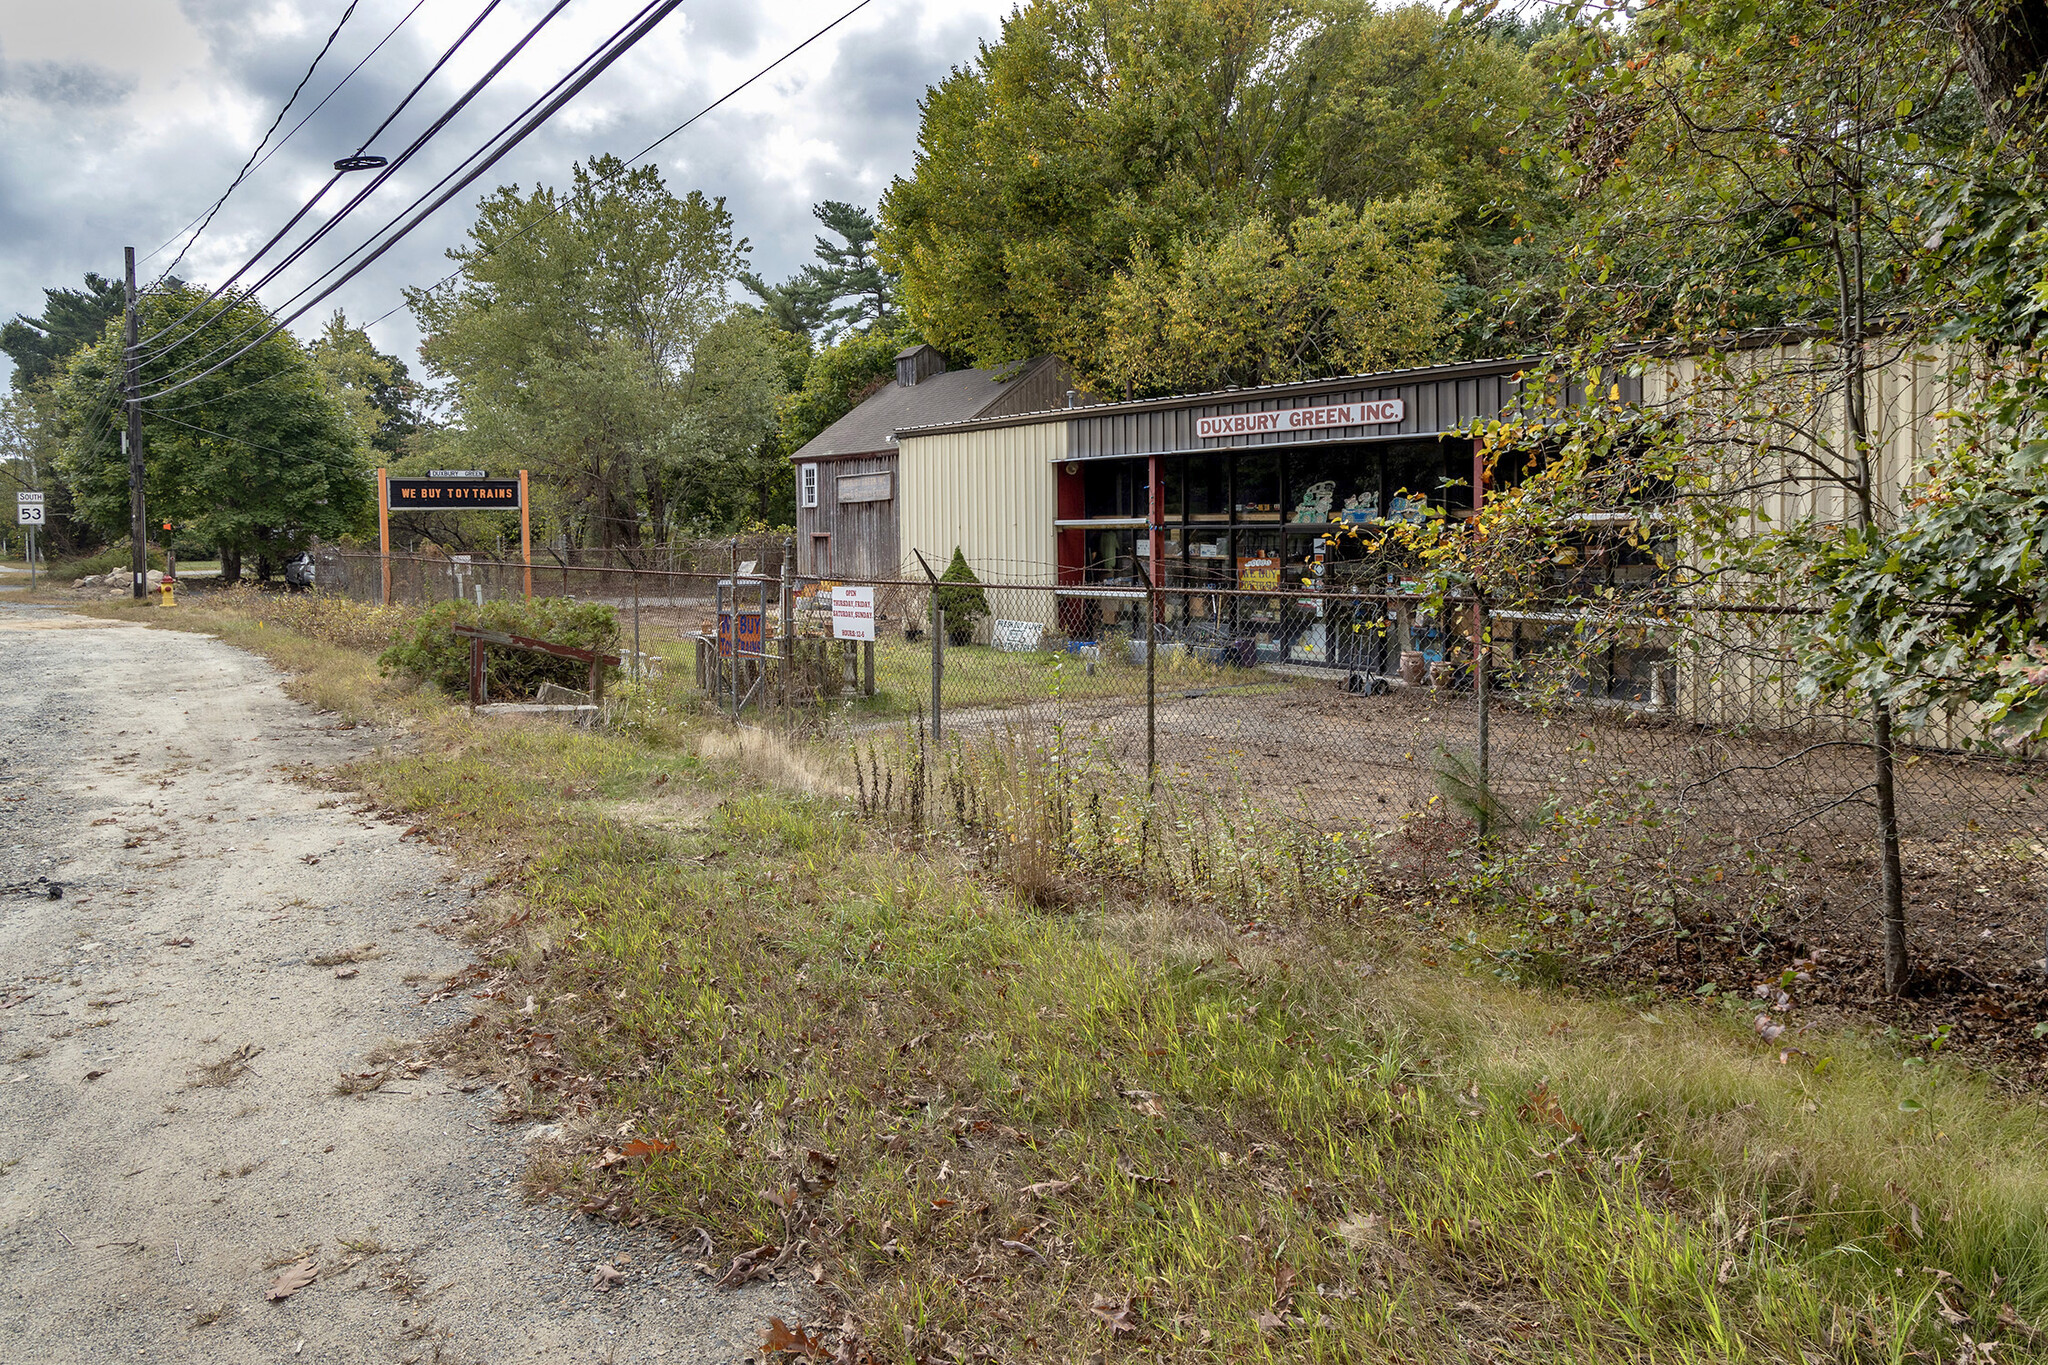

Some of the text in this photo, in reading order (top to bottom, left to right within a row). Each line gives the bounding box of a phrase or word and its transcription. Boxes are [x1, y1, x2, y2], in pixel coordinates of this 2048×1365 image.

[1200, 403, 1399, 435] DUXBURY GREEN, INC.
[19, 492, 42, 501] SOUTH
[401, 488, 513, 499] WE BUY TOY TRAINS
[21, 508, 42, 520] 53
[1258, 568, 1276, 579] BUY
[833, 600, 873, 609] THURSDAY, FRIDAY,
[832, 610, 855, 619] SATURDAY,
[740, 615, 761, 634] BUY
